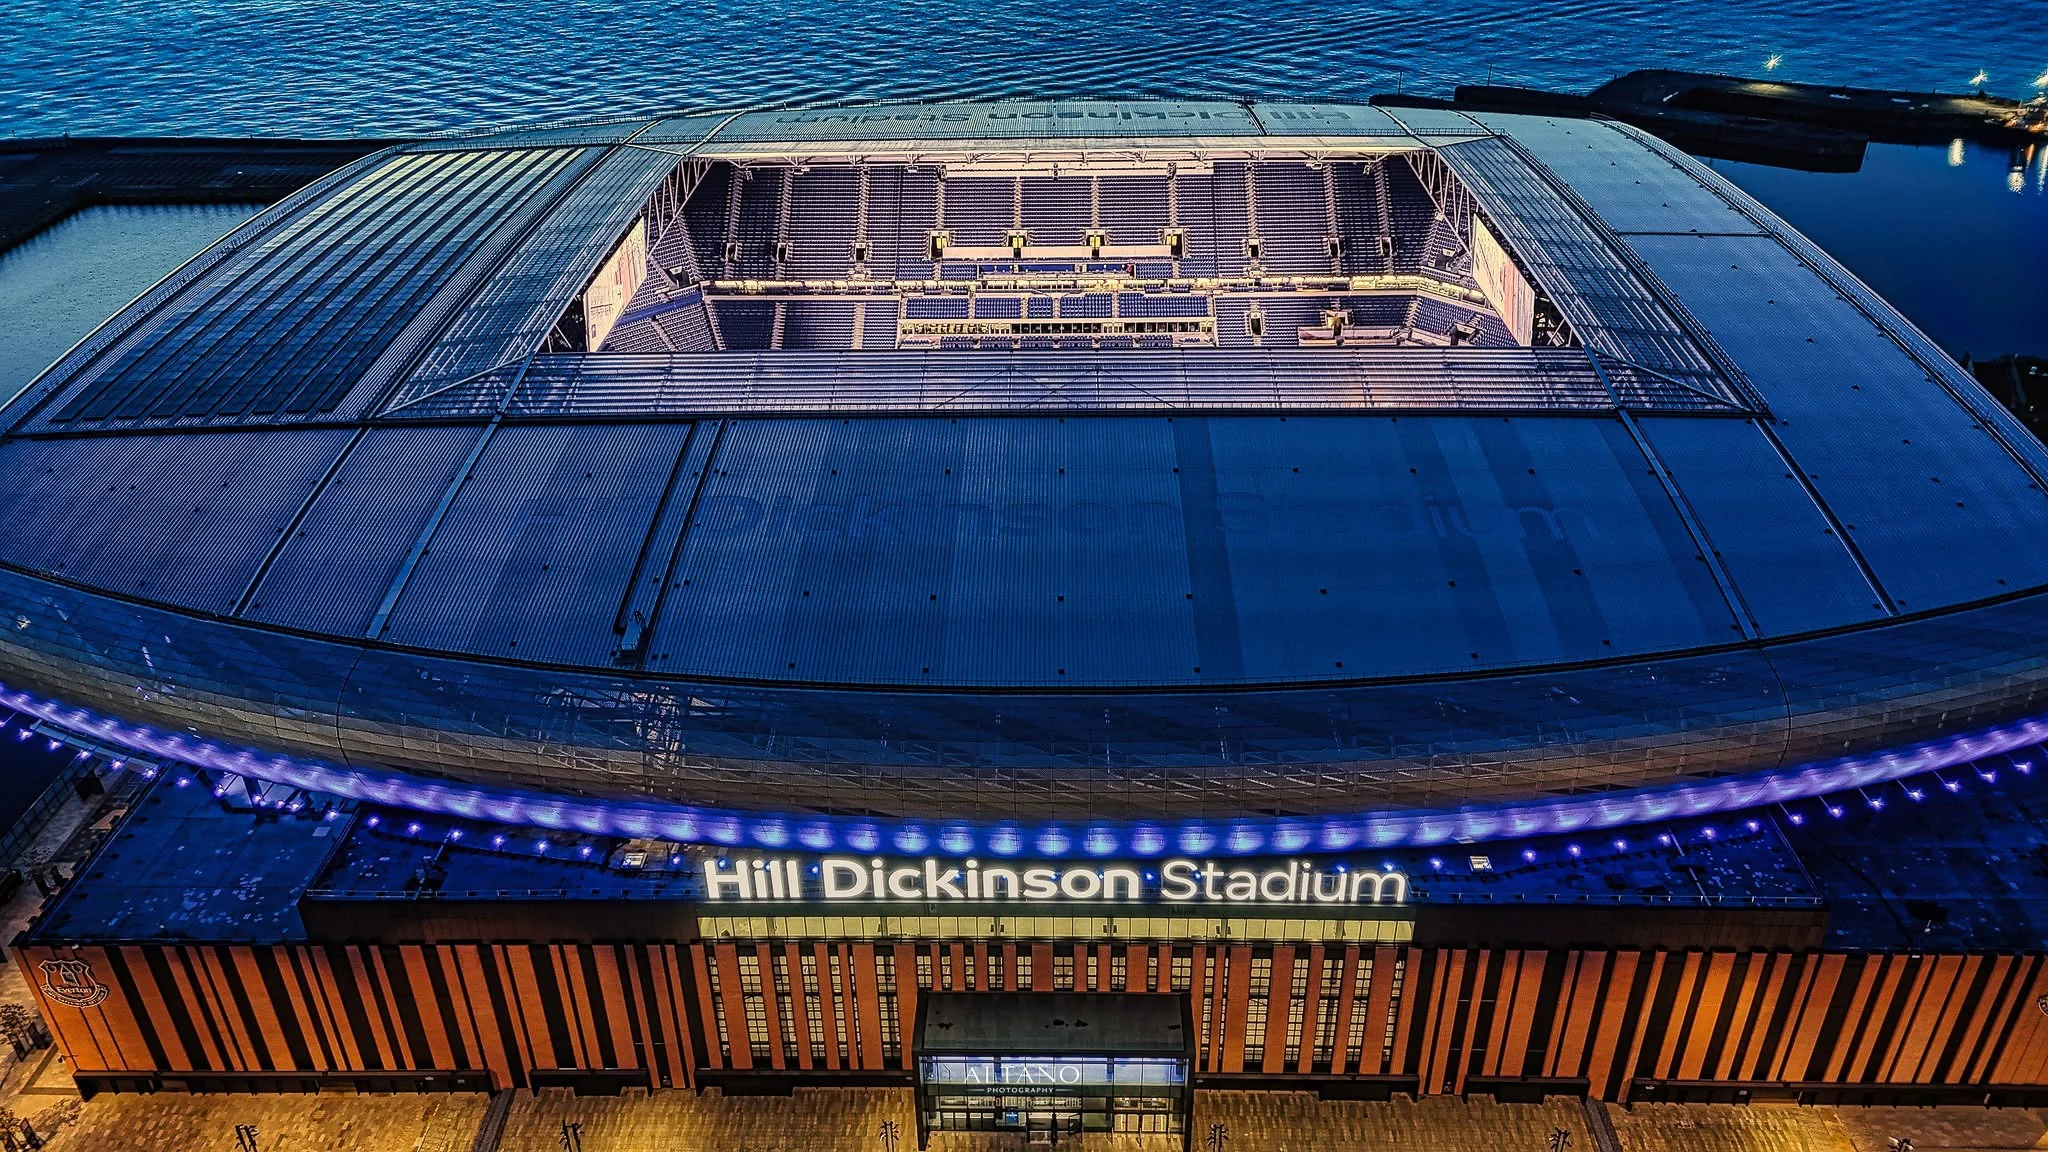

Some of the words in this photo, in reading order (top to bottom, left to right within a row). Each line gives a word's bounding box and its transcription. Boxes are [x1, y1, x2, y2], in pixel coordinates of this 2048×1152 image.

[775, 113, 971, 124] Stadium
[988, 111, 1250, 120] Dickinson
[1269, 111, 1351, 120] Hill
[703, 858, 801, 899] Hill
[822, 858, 1140, 899] Dickinson
[1161, 860, 1406, 902] Stadium
[57, 986, 93, 994] Everton
